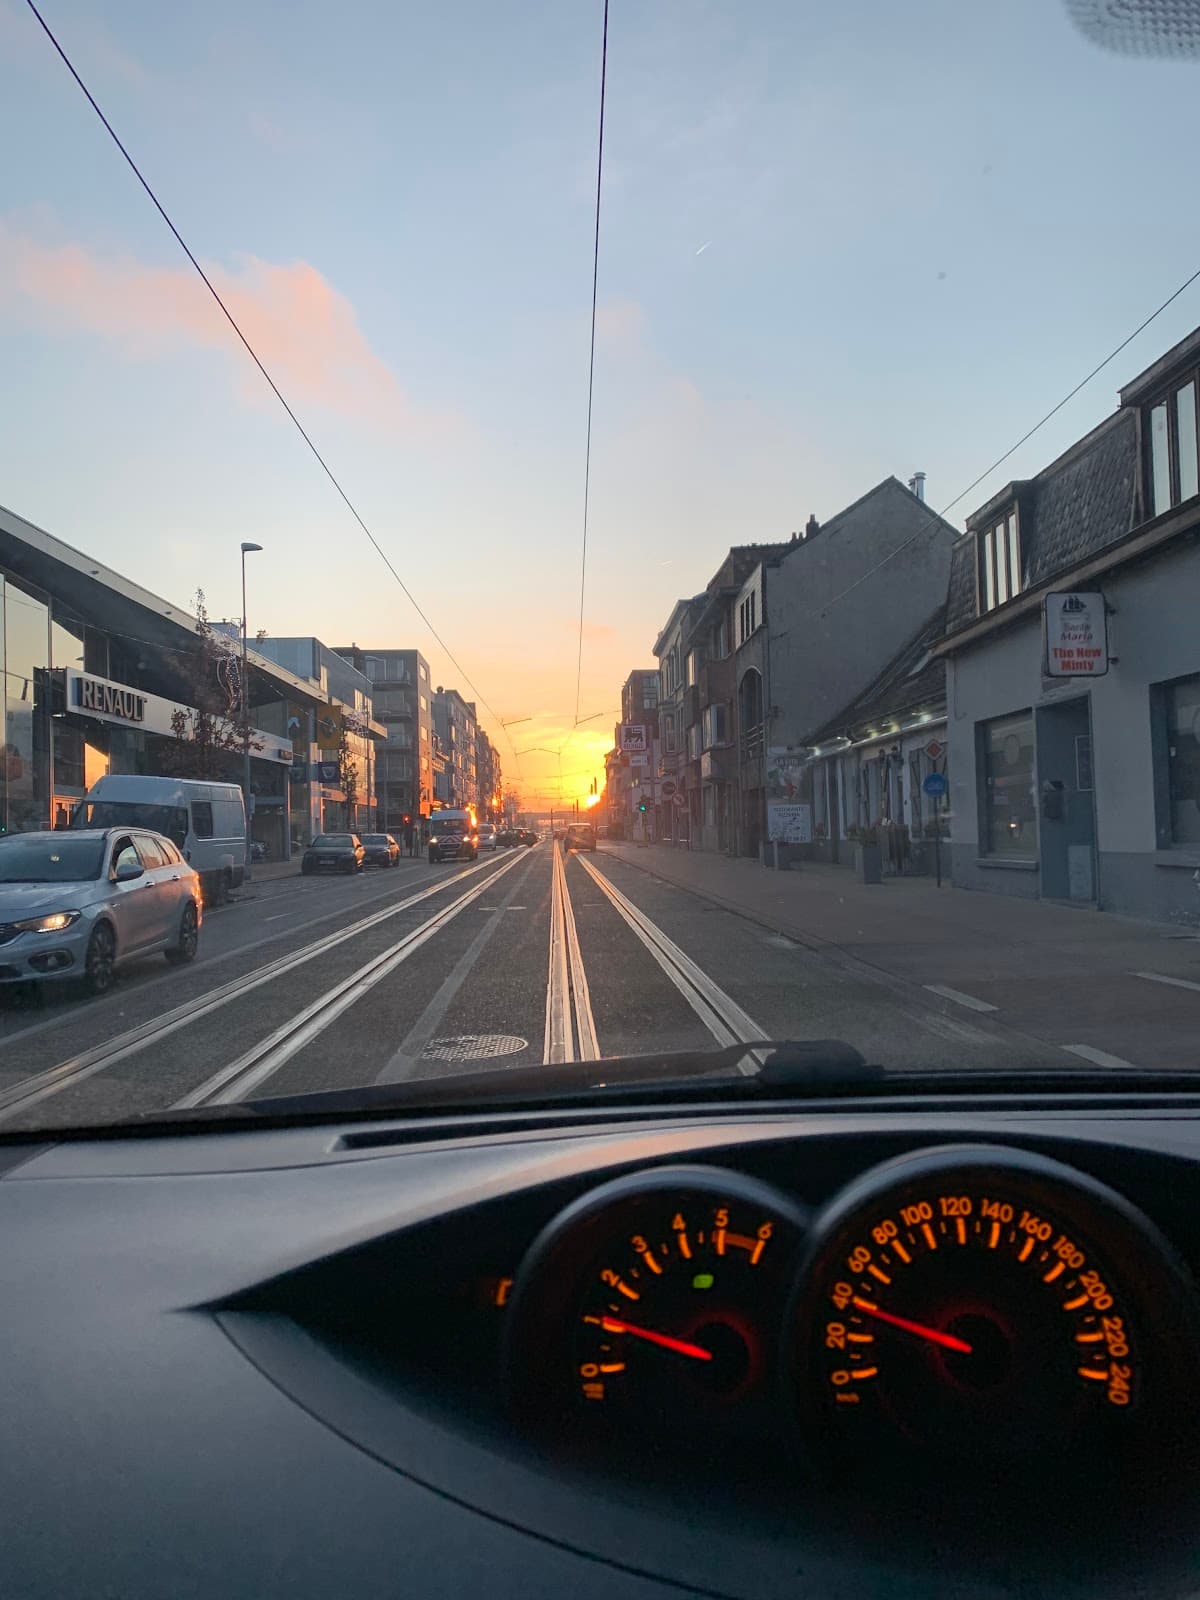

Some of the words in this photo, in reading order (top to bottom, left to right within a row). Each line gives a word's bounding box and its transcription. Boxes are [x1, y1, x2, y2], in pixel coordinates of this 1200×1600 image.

[1060, 631, 1094, 641] Maria
[1053, 647, 1074, 658] The
[1076, 647, 1102, 658] New
[1060, 660, 1094, 671] Minty
[81, 677, 147, 721] RENAULT
[715, 1208, 728, 1228] 5
[900, 1202, 933, 1226] 100
[939, 1197, 972, 1216] 120
[981, 1199, 1013, 1223] 140
[672, 1213, 686, 1231] 4
[758, 1221, 772, 1240] 6
[872, 1219, 898, 1245] 80
[1018, 1211, 1052, 1242] 160
[632, 1235, 648, 1254] 3
[1052, 1235, 1085, 1269] 180
[848, 1246, 871, 1273] 60
[601, 1269, 619, 1287] 2
[832, 1281, 853, 1309] 40
[1079, 1270, 1113, 1311] 200
[826, 1323, 846, 1349] 20
[1102, 1316, 1129, 1357] 220
[581, 1363, 599, 1378] 0
[831, 1370, 850, 1385] 0
[1109, 1365, 1130, 1404] 240
